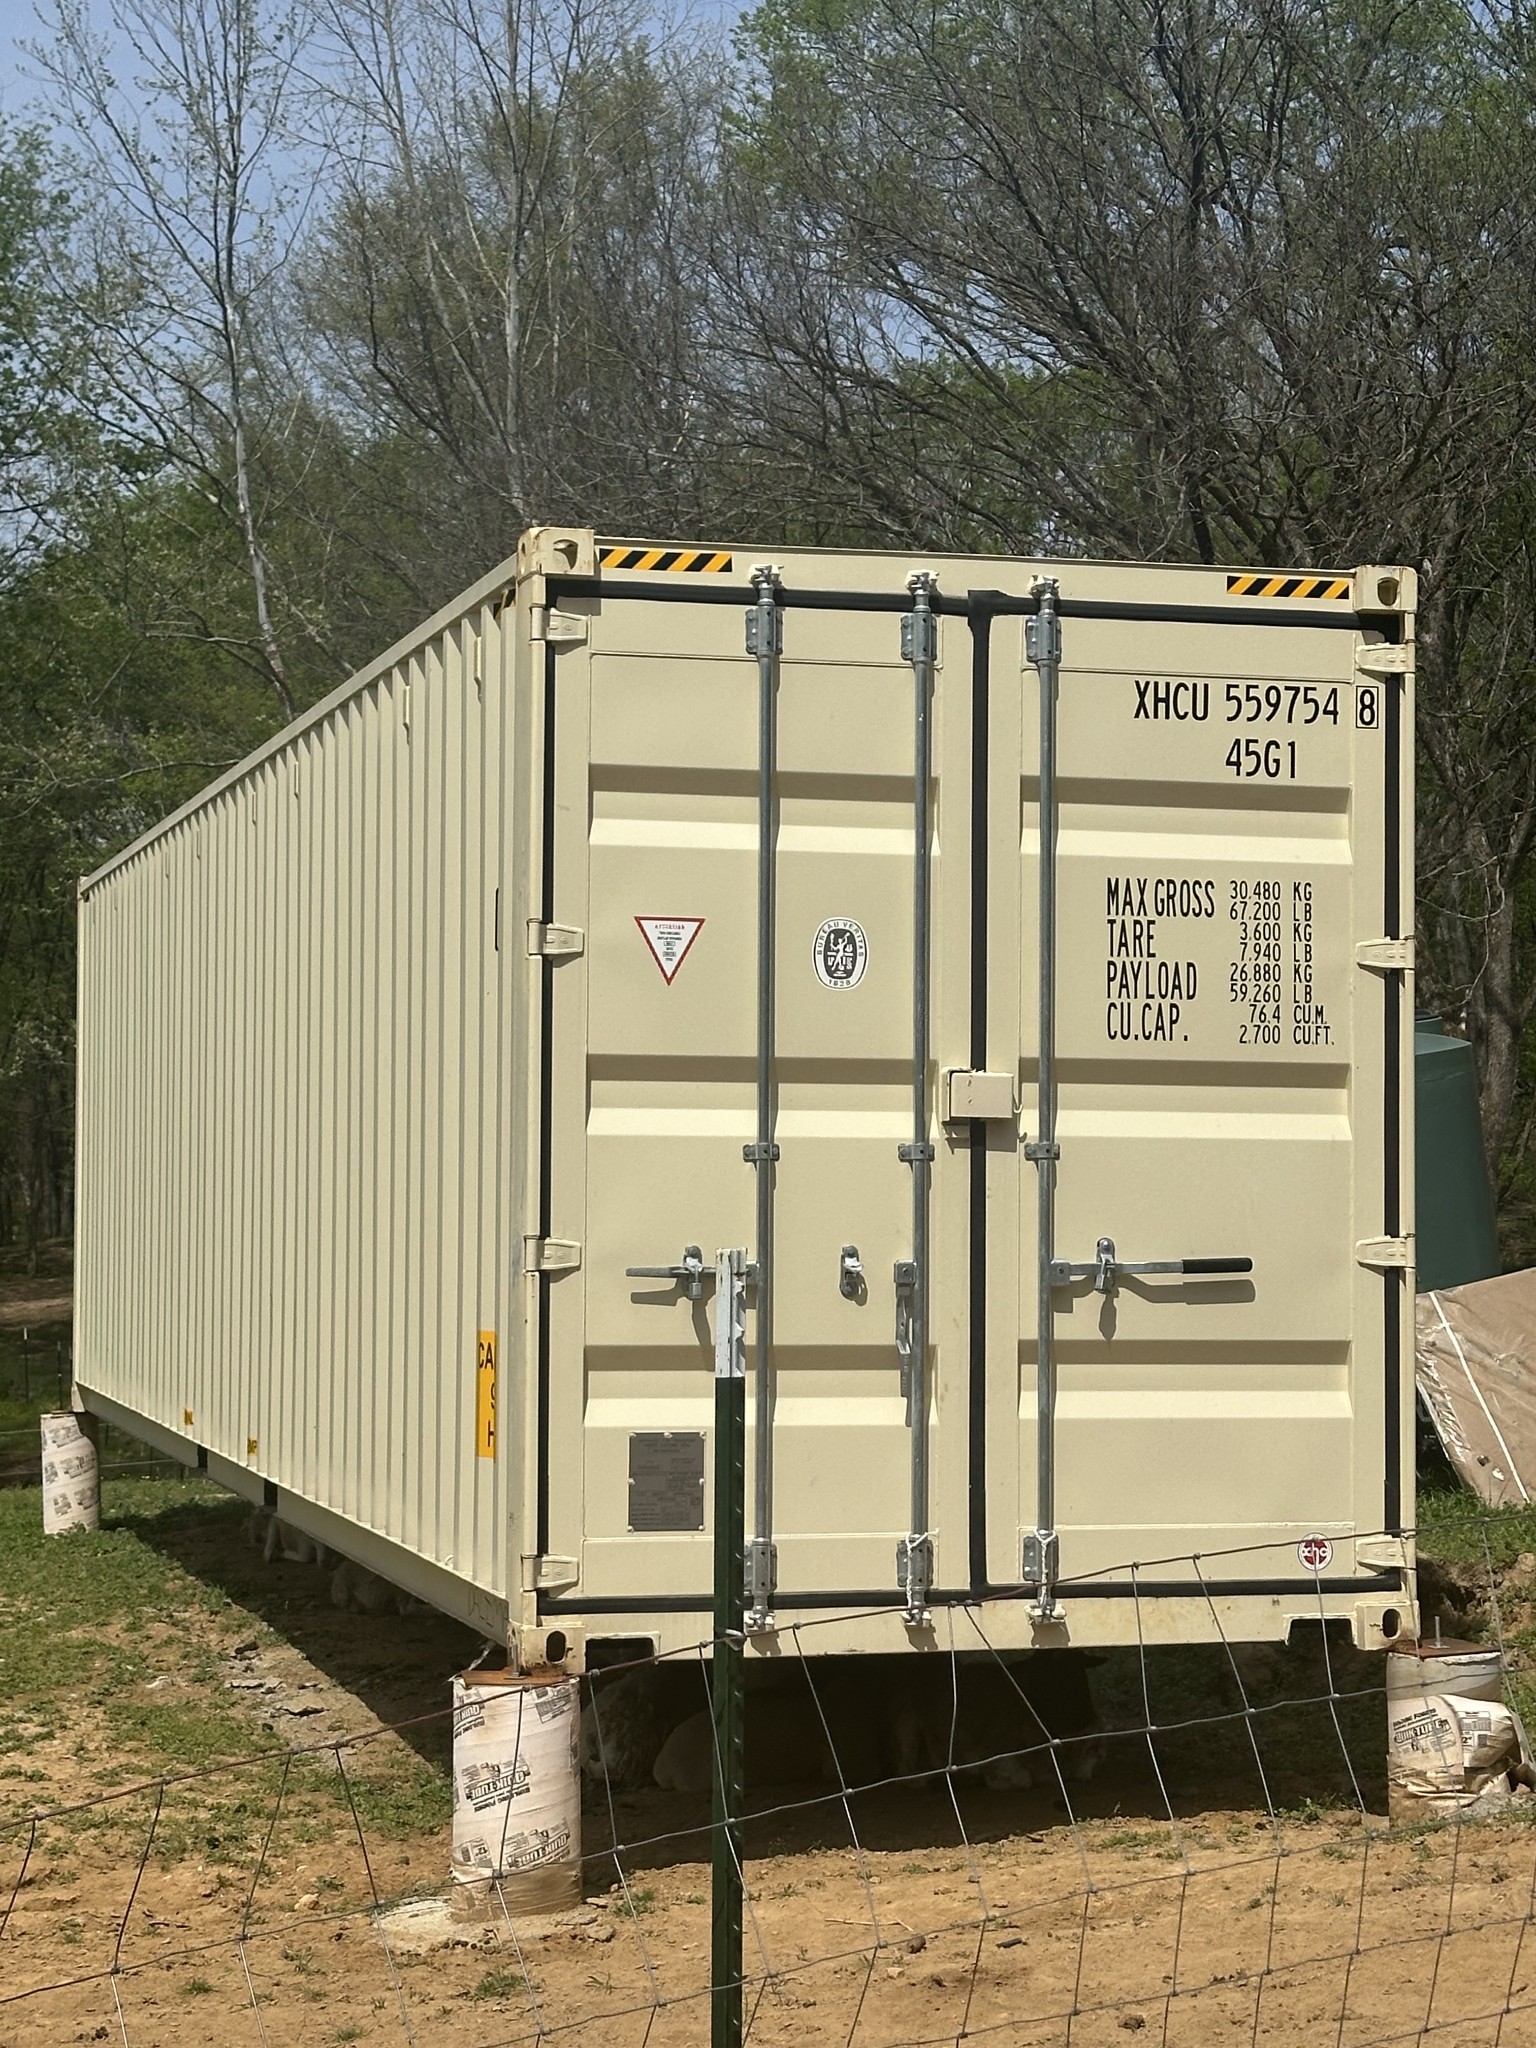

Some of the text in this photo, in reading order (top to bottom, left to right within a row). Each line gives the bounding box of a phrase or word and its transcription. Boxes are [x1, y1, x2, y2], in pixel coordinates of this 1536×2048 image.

[1133, 680, 1377, 727] XHCU 559754 8
[1225, 738, 1296, 779] 45G1
[1106, 877, 1148, 917] MAX
[1153, 878, 1215, 918] GROSS
[1293, 881, 1312, 901] KG
[1293, 901, 1312, 921] LB
[816, 921, 865, 957] BUREAU VERITAS
[1106, 918, 1157, 958] TARE
[1293, 922, 1312, 942] KG
[1293, 942, 1312, 963] LB
[1106, 960, 1197, 1000] PAYLOAD
[1293, 963, 1312, 983] KG
[1293, 983, 1312, 1004] LB
[1249, 1003, 1281, 1024] 76.4
